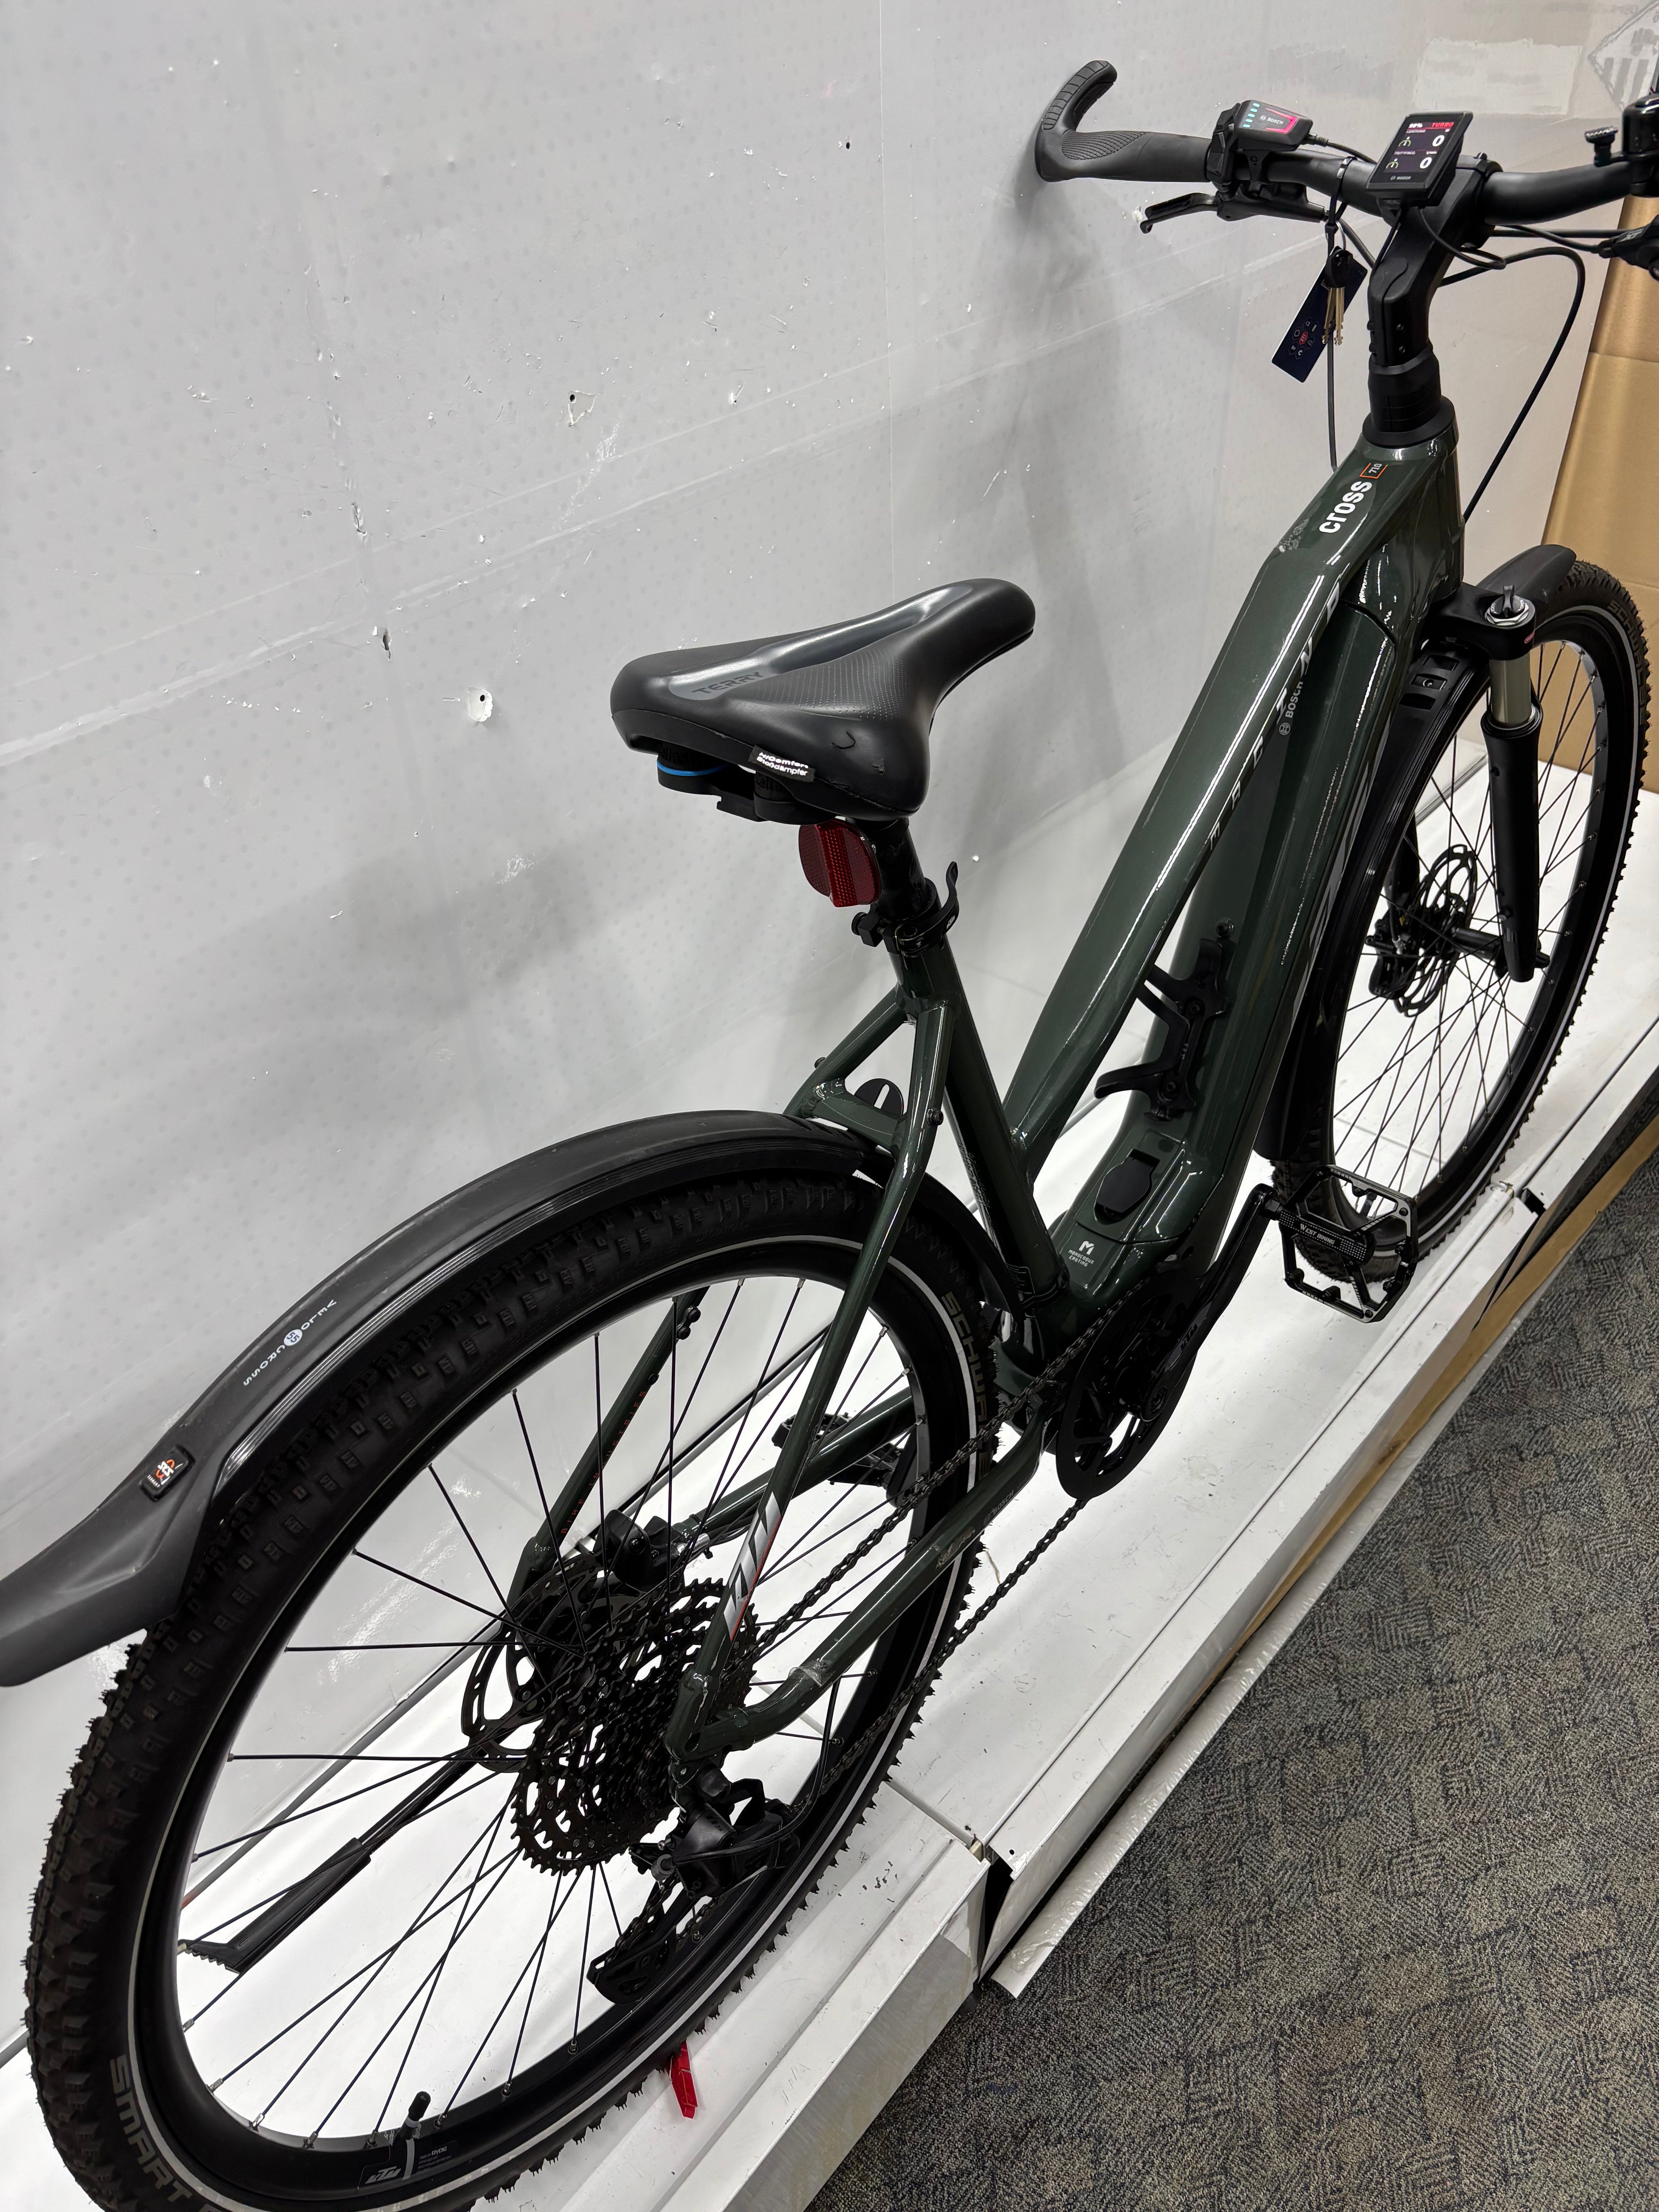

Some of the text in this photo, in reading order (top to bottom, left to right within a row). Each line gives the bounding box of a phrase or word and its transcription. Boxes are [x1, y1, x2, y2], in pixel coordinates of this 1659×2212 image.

[1432, 135, 1445, 147] 0
[1420, 157, 1432, 169] 0
[1368, 463, 1382, 474] 710
[1607, 600, 1646, 725] SCHWALBE
[692, 672, 763, 693] TERRY
[1317, 1233, 1335, 1245] BIKING
[1068, 1249, 1095, 1265] MONOCOQUE
[1069, 1255, 1088, 1267] CASTING
[243, 1300, 337, 1386] VELO 55 CROSS
[993, 1490, 1014, 1516] BOSCH
[561, 1499, 584, 1534] BIKE
[723, 1491, 782, 1640] KTM
[110, 2054, 193, 2203] SMART
[365, 2166, 402, 2184] KTM
